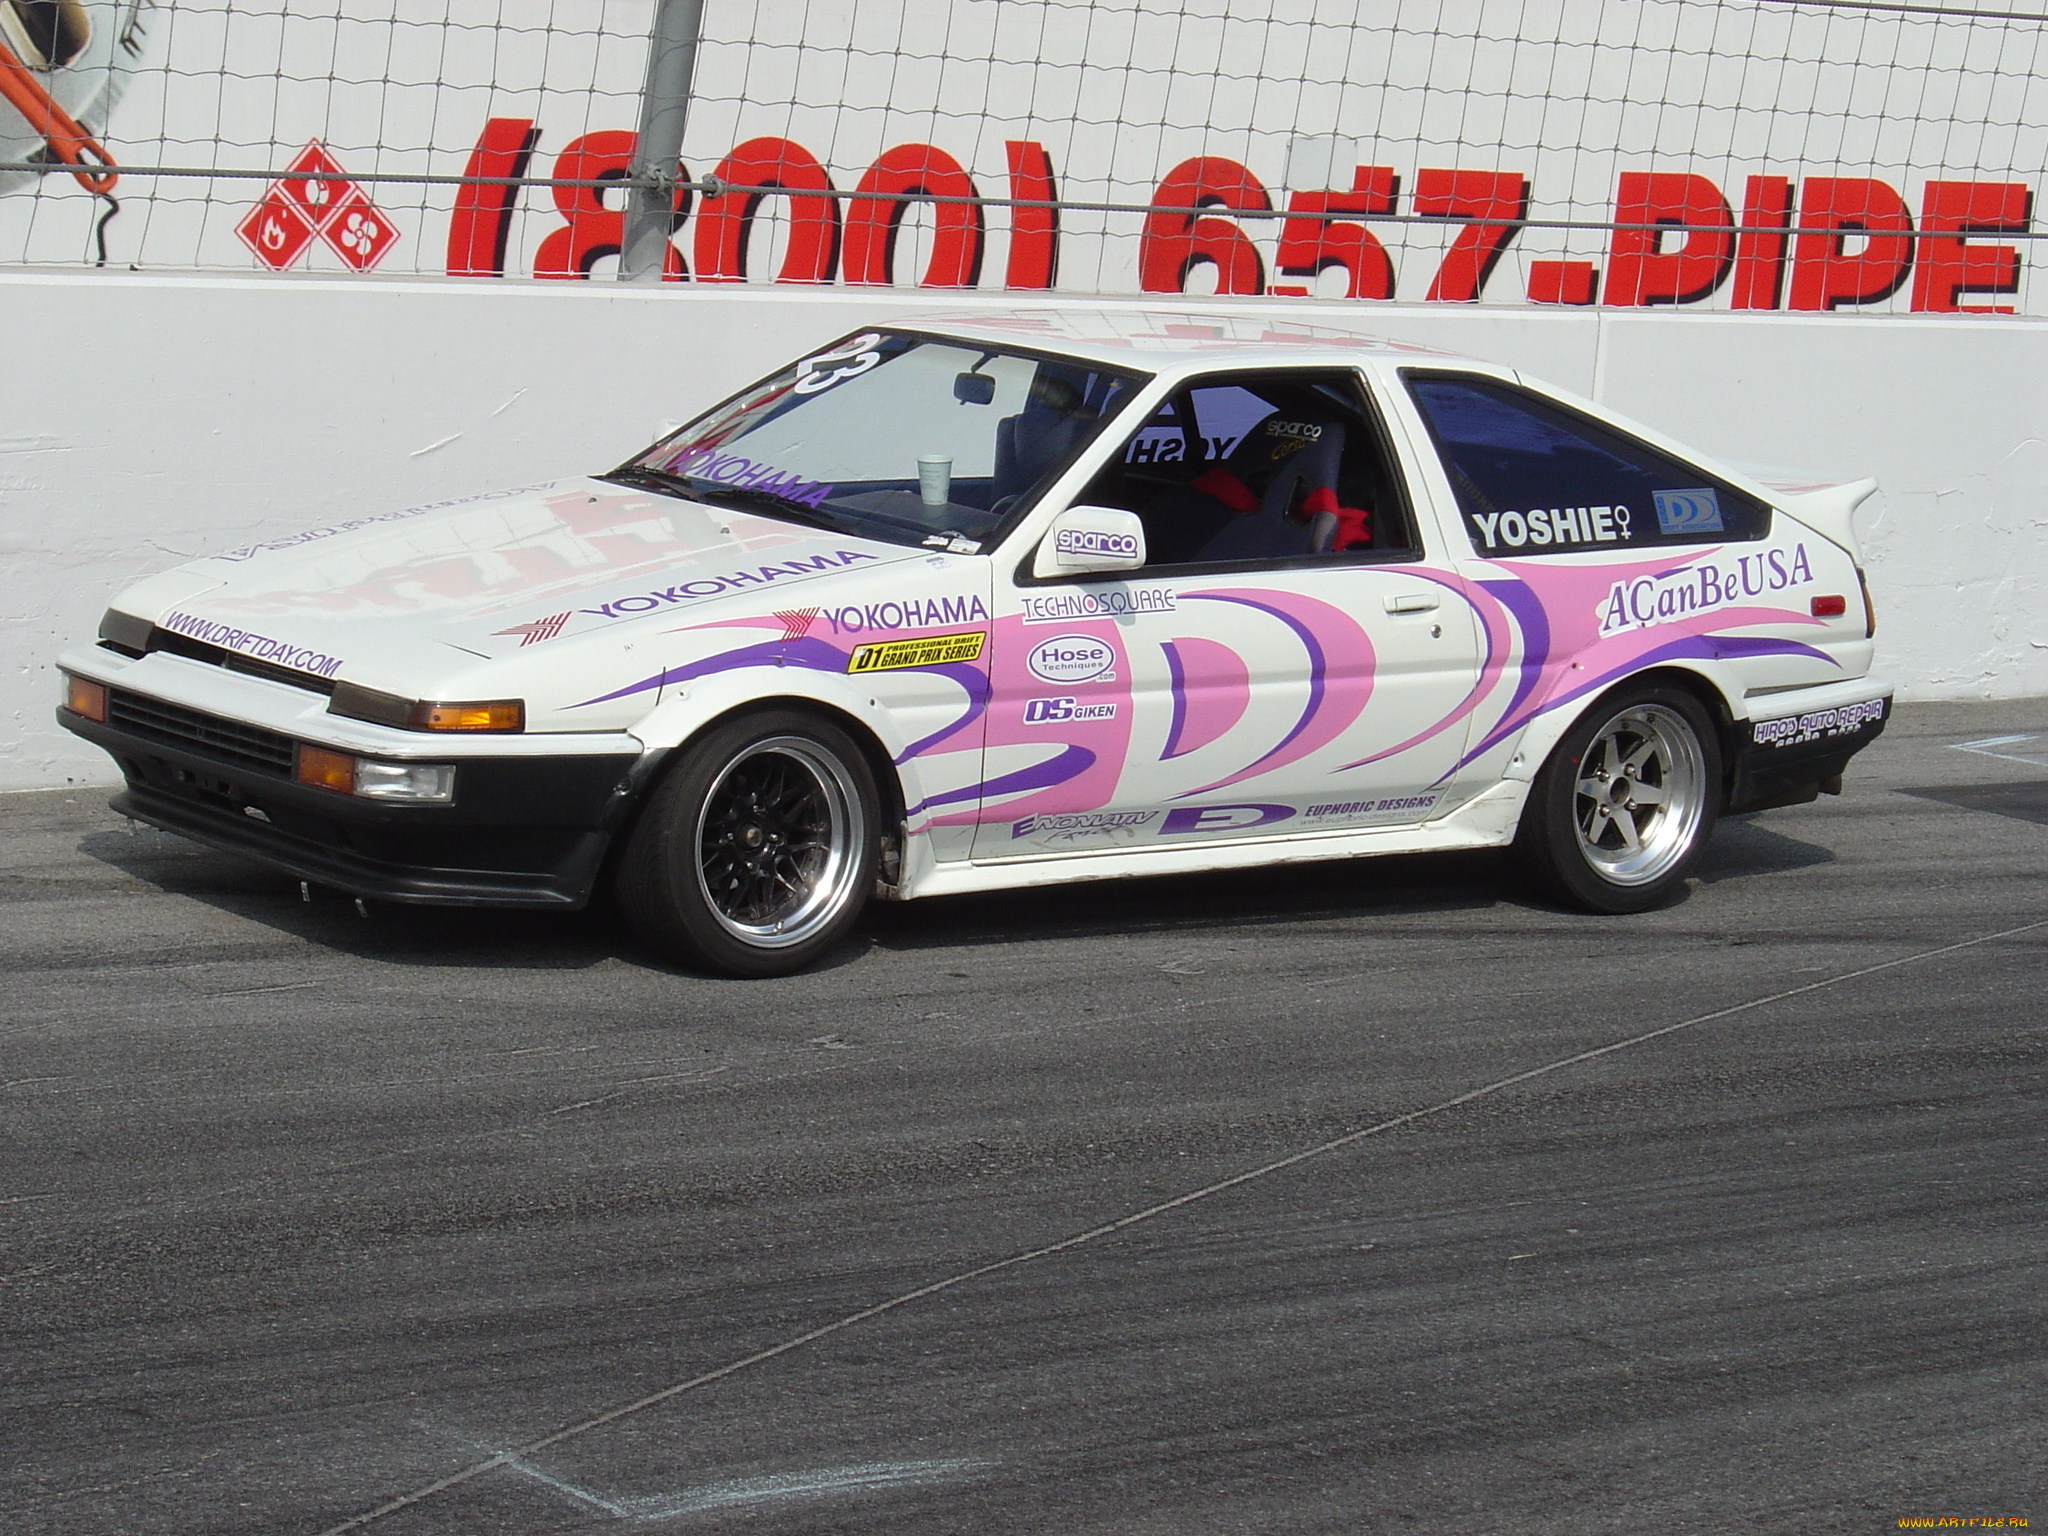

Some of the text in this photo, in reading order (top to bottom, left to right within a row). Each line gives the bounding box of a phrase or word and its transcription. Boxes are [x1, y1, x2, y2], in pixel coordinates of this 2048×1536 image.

[794, 333, 881, 394] 23
[1267, 421, 1322, 437] sparco
[664, 446, 833, 508] YOKOHAMA
[1058, 529, 1137, 553] sparco
[1472, 507, 1617, 548] YOSHIE
[579, 549, 878, 619] YOKOHAMA
[1602, 543, 1814, 631] ACanBeUSA
[823, 594, 988, 635] YOKOHAMA
[1021, 589, 1176, 619] TECHNOSQUARE
[164, 611, 343, 678] WWW.DRIFTDAY.COM
[881, 650, 918, 667] GRAND
[919, 647, 943, 664] PRIX
[942, 643, 979, 661] SERIES
[886, 635, 981, 652] PROFESSIONAL DRIFT
[1041, 648, 1104, 662] Hose
[1043, 661, 1104, 670] Techniques
[1026, 698, 1115, 722] OS GIKEN
[1754, 717, 1798, 743] HIRO'S
[1799, 709, 1838, 735] AUTO
[1837, 699, 1883, 726] REPAIR
[1304, 795, 1436, 817] EUPHORIC DESIGNS
